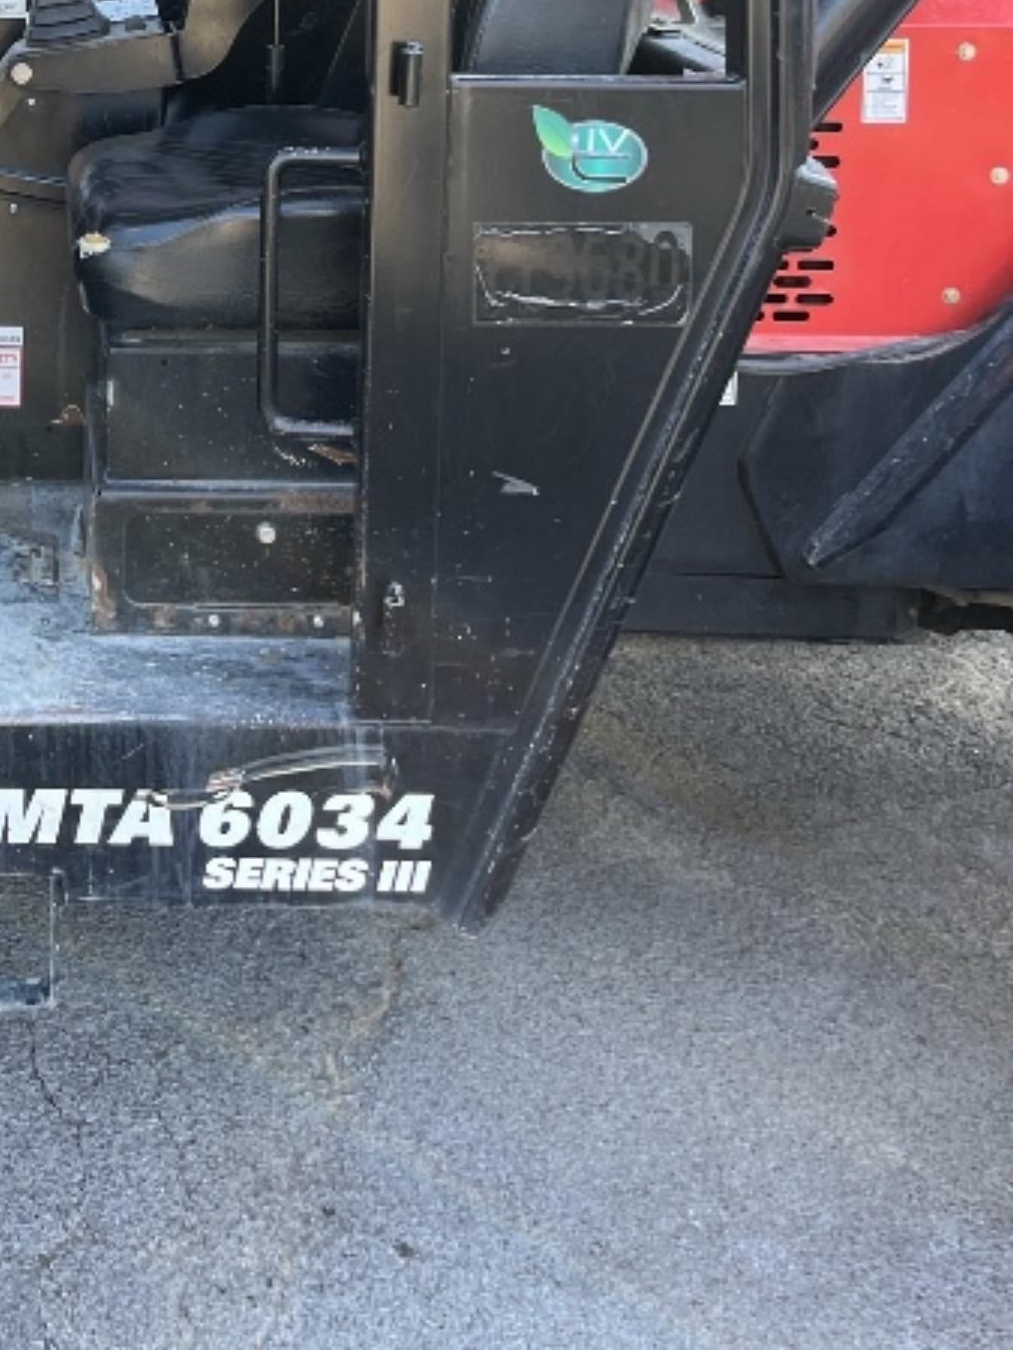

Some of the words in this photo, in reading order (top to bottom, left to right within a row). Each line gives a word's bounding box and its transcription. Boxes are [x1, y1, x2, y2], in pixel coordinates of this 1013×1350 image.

[198, 791, 436, 850] 6034
[201, 857, 369, 893] SERIES
[375, 859, 432, 893] III
